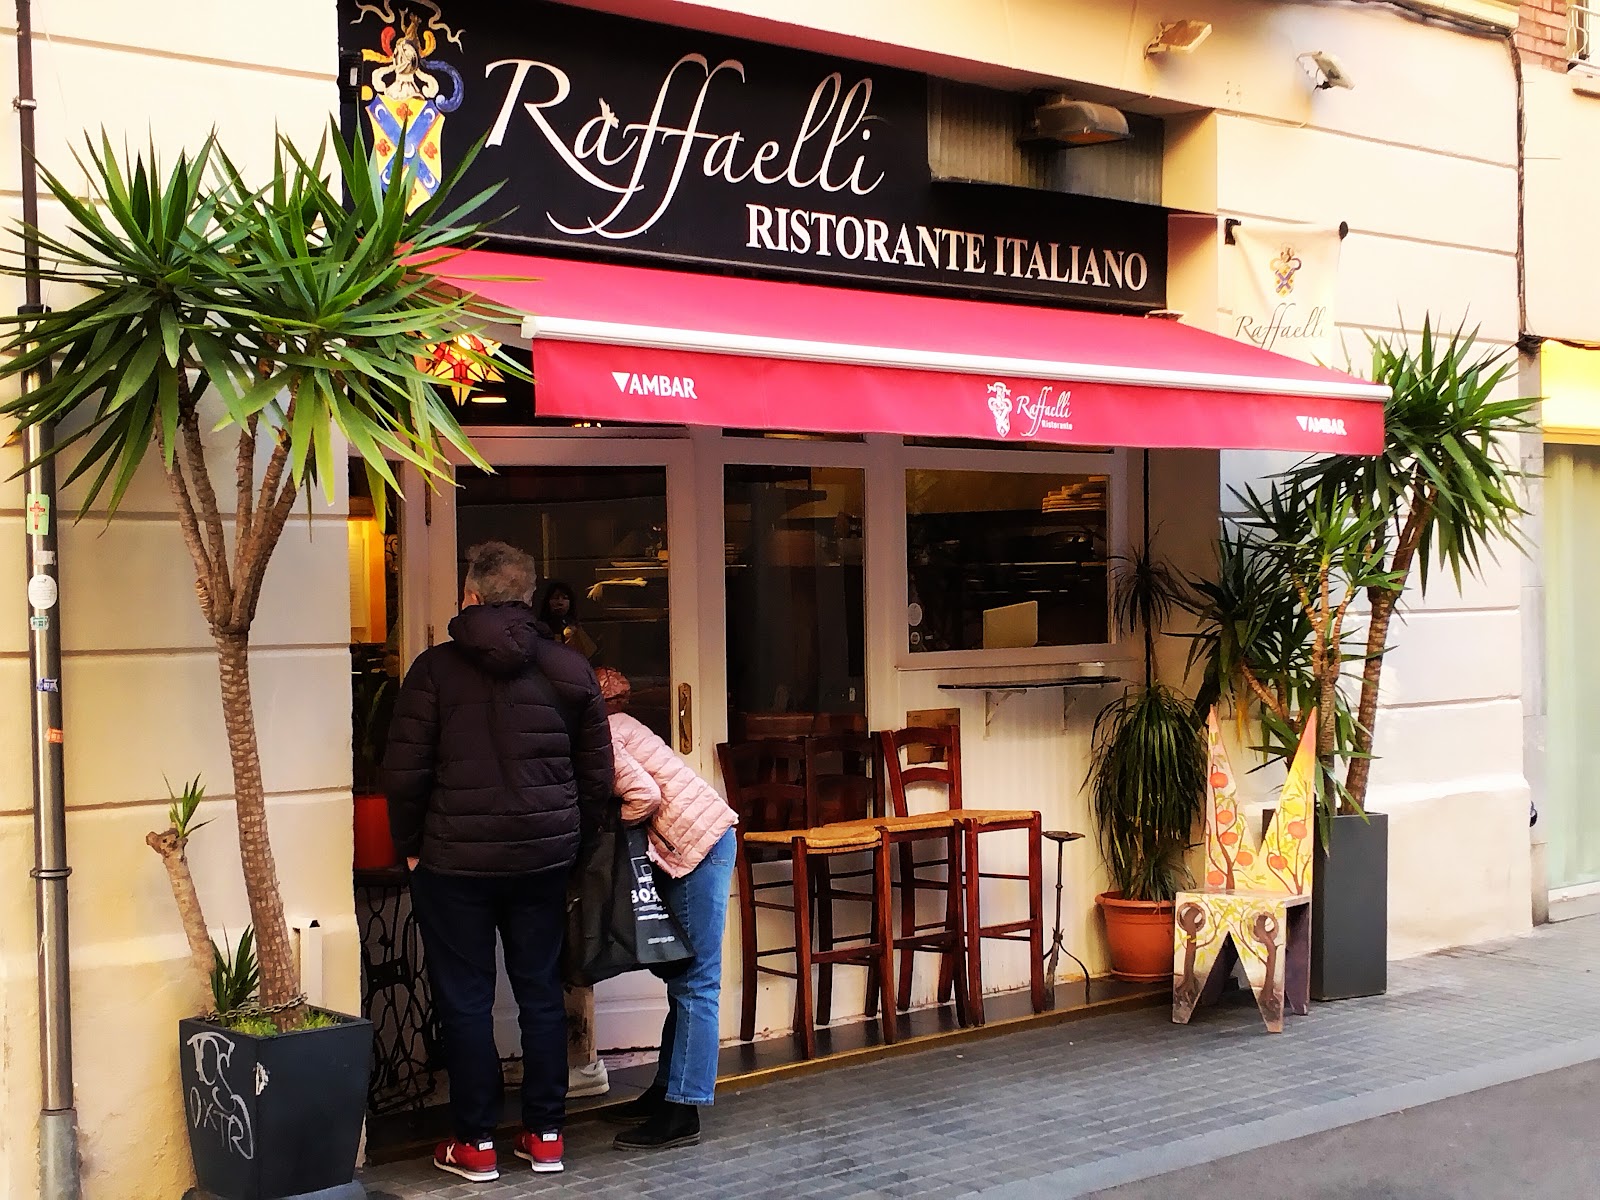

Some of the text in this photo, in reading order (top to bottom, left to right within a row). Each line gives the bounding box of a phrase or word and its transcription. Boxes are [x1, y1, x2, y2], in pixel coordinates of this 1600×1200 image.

[485, 53, 885, 239] Raffaelli
[745, 203, 1149, 291] RISTORANTE ITALIANO
[629, 373, 698, 400] AMBAR
[1016, 386, 1072, 437] Raffaelli
[1308, 416, 1348, 436] AMBAR
